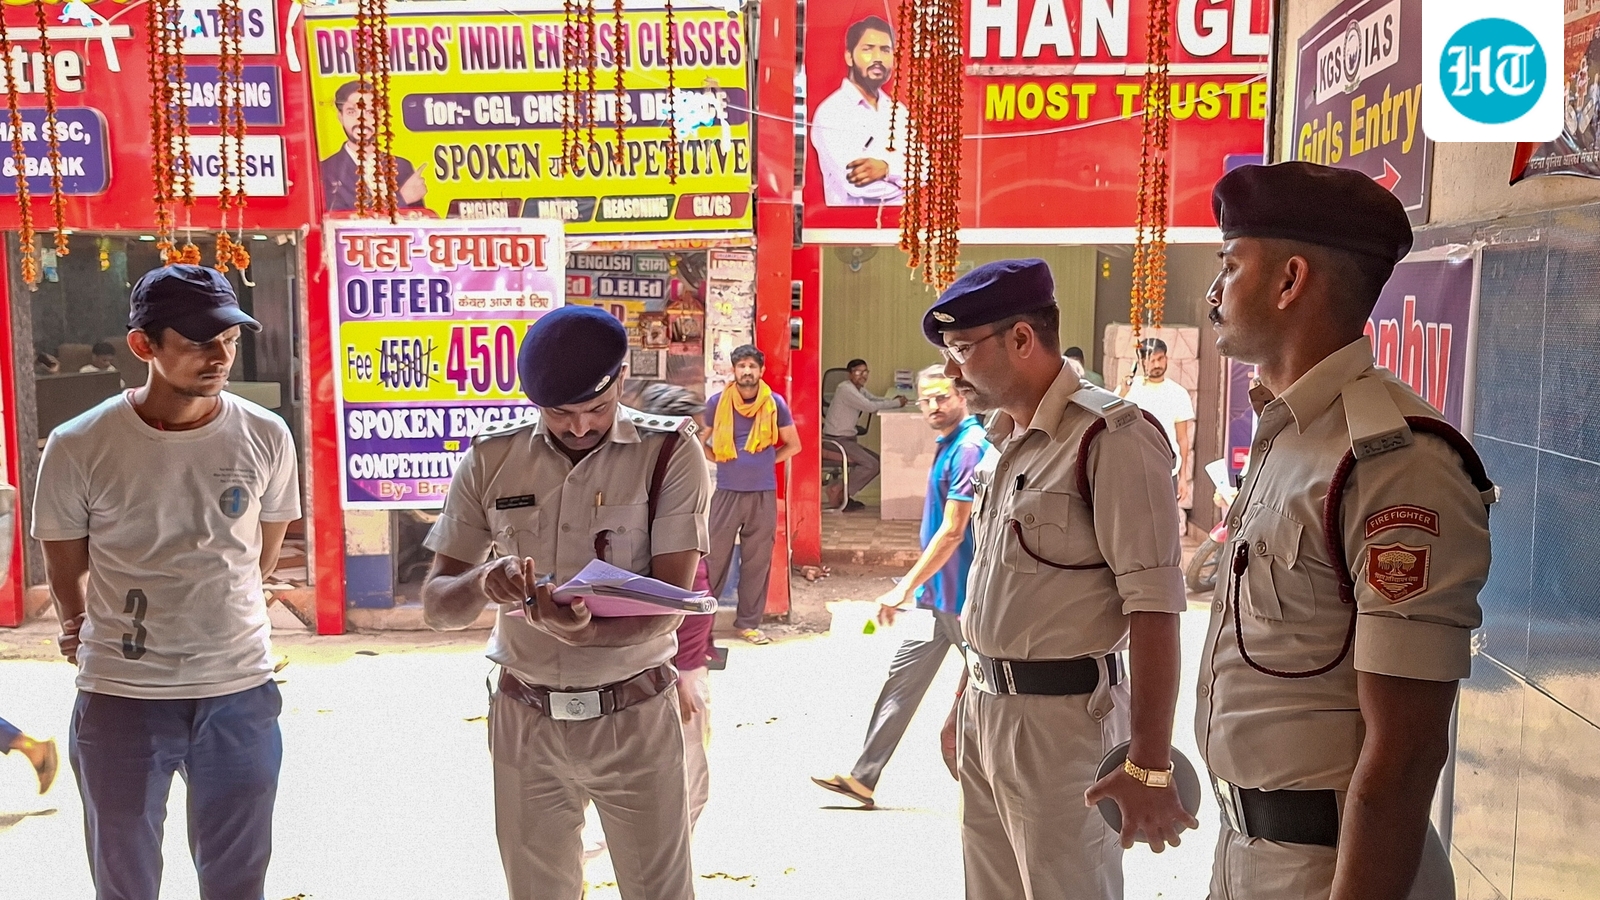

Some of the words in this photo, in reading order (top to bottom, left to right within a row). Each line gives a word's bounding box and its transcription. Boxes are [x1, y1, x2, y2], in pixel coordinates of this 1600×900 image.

[459, 23, 528, 70] INDIA
[638, 19, 742, 67] CLASSES
[1319, 45, 1342, 93] KGS
[1364, 13, 1393, 68] IAS
[473, 96, 521, 126] CGL,
[640, 91, 729, 121] DECE
[985, 84, 1097, 121] MOST
[41, 121, 91, 145] SSC,
[1297, 111, 1343, 166] Girls
[1349, 82, 1422, 157] Entry
[24, 156, 86, 177] BANK
[172, 154, 275, 177] ENGSH
[434, 143, 540, 181] SPOKEN
[570, 138, 749, 178] COMPETITIVE
[602, 197, 668, 218] REASONING
[693, 195, 731, 216] GK/GS
[578, 255, 631, 271] ENGLISH
[346, 278, 450, 315] OFFER
[347, 346, 372, 380] Fee
[446, 325, 531, 393] 450
[349, 408, 445, 439] SPOKEN
[350, 451, 465, 479] COMPETITIV
[1370, 514, 1390, 528] FIRE
[1390, 511, 1431, 524] FIGHTER
[122, 588, 148, 660] 3
